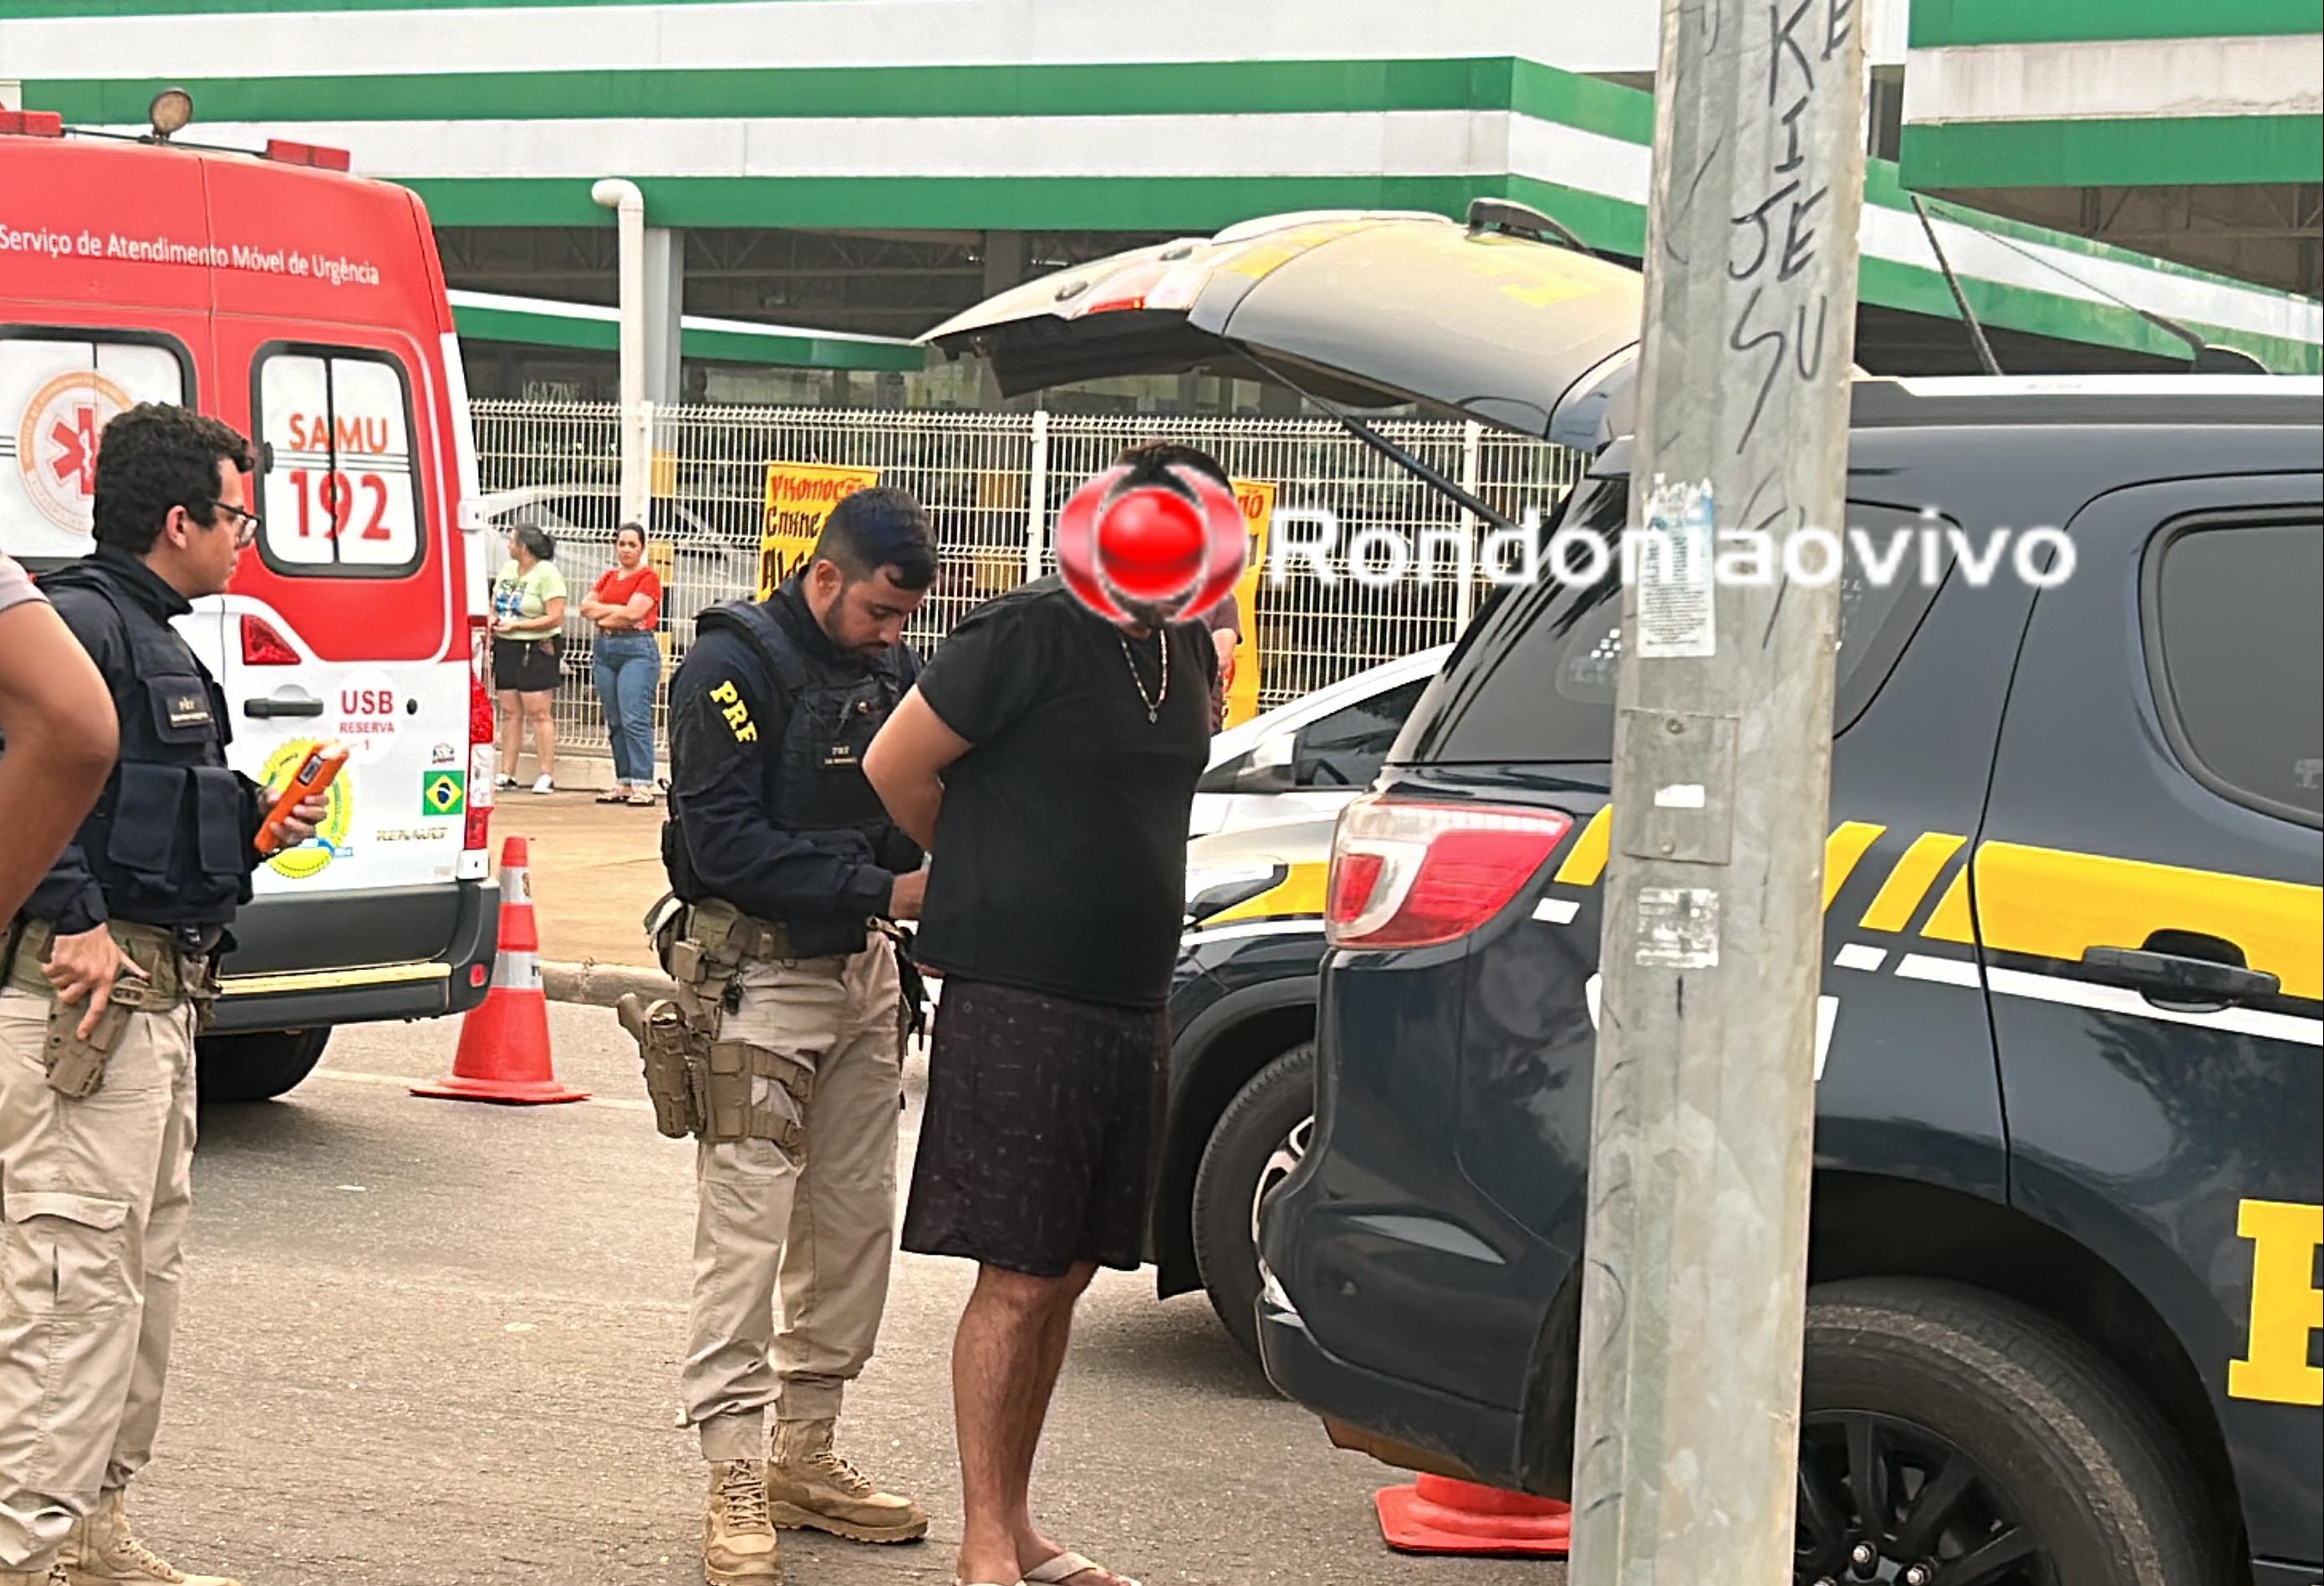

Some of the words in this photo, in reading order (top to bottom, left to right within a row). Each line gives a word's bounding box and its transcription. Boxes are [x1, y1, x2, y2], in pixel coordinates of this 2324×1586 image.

[0, 224, 70, 259] Serviço
[77, 231, 102, 257] de
[107, 233, 228, 268] Atendimento
[232, 244, 285, 273] Móvel
[288, 252, 309, 277] de
[313, 253, 380, 286] Urgência
[288, 412, 388, 455] SAMU
[288, 468, 391, 542] 192
[339, 722, 395, 734] RESERVA
[340, 690, 395, 716] USB
[709, 680, 759, 743] PRF
